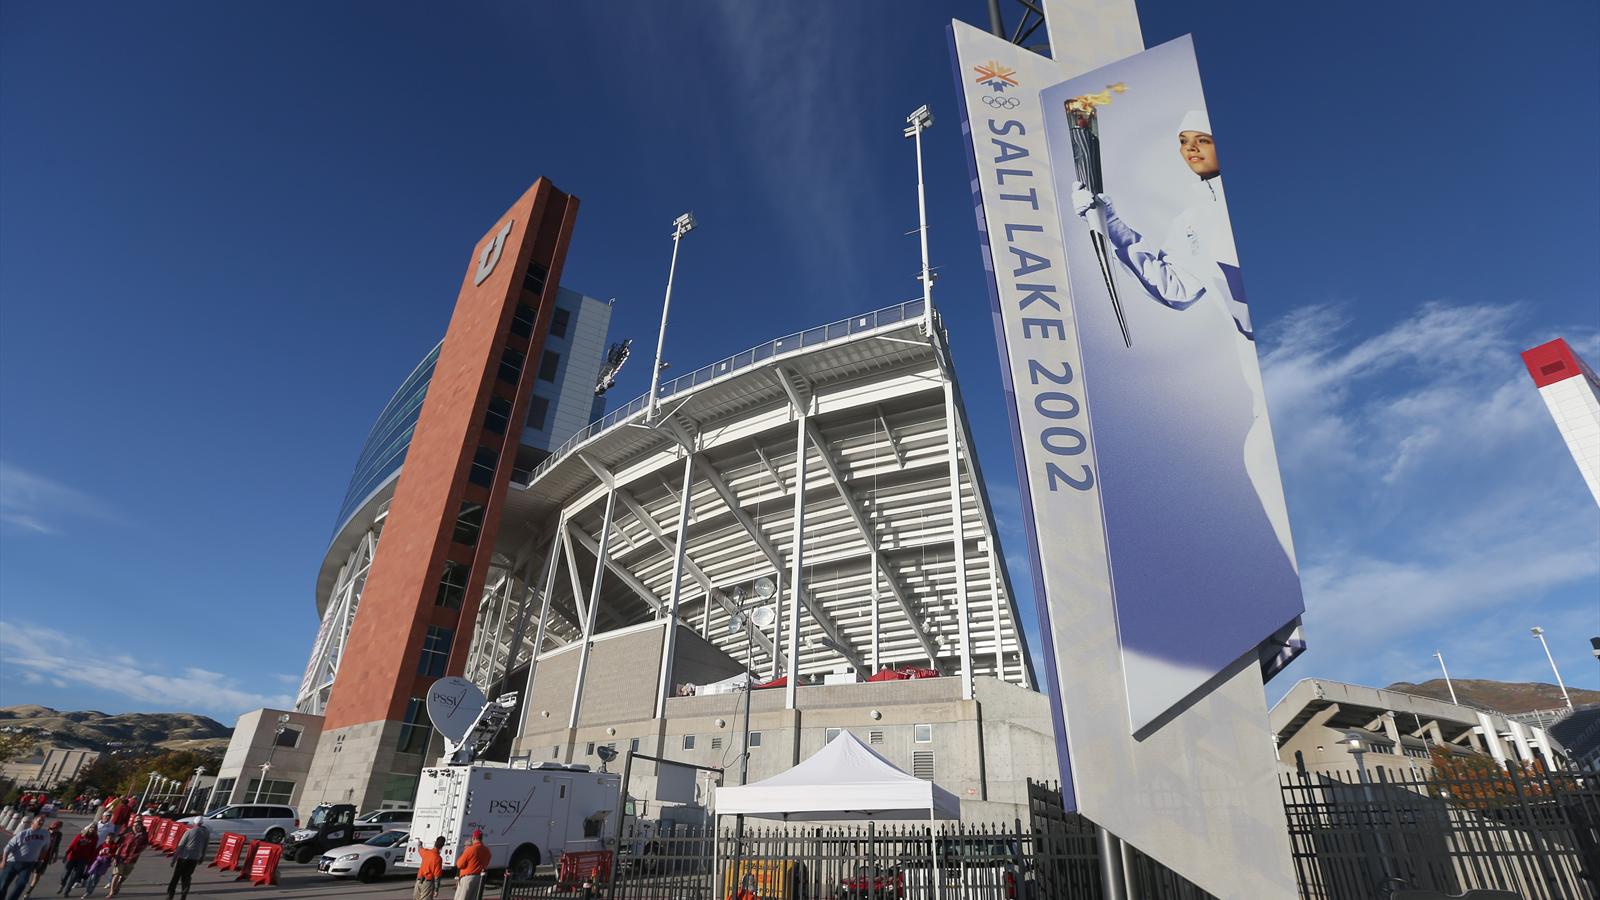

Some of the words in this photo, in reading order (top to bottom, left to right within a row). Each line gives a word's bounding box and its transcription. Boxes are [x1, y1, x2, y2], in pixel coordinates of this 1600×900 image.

[988, 119, 1040, 211] SALT
[474, 219, 514, 287] U
[1004, 223, 1066, 341] LAKE
[1027, 359, 1095, 492] 2002
[433, 692, 458, 706] PSSI
[488, 799, 522, 814] PSSI
